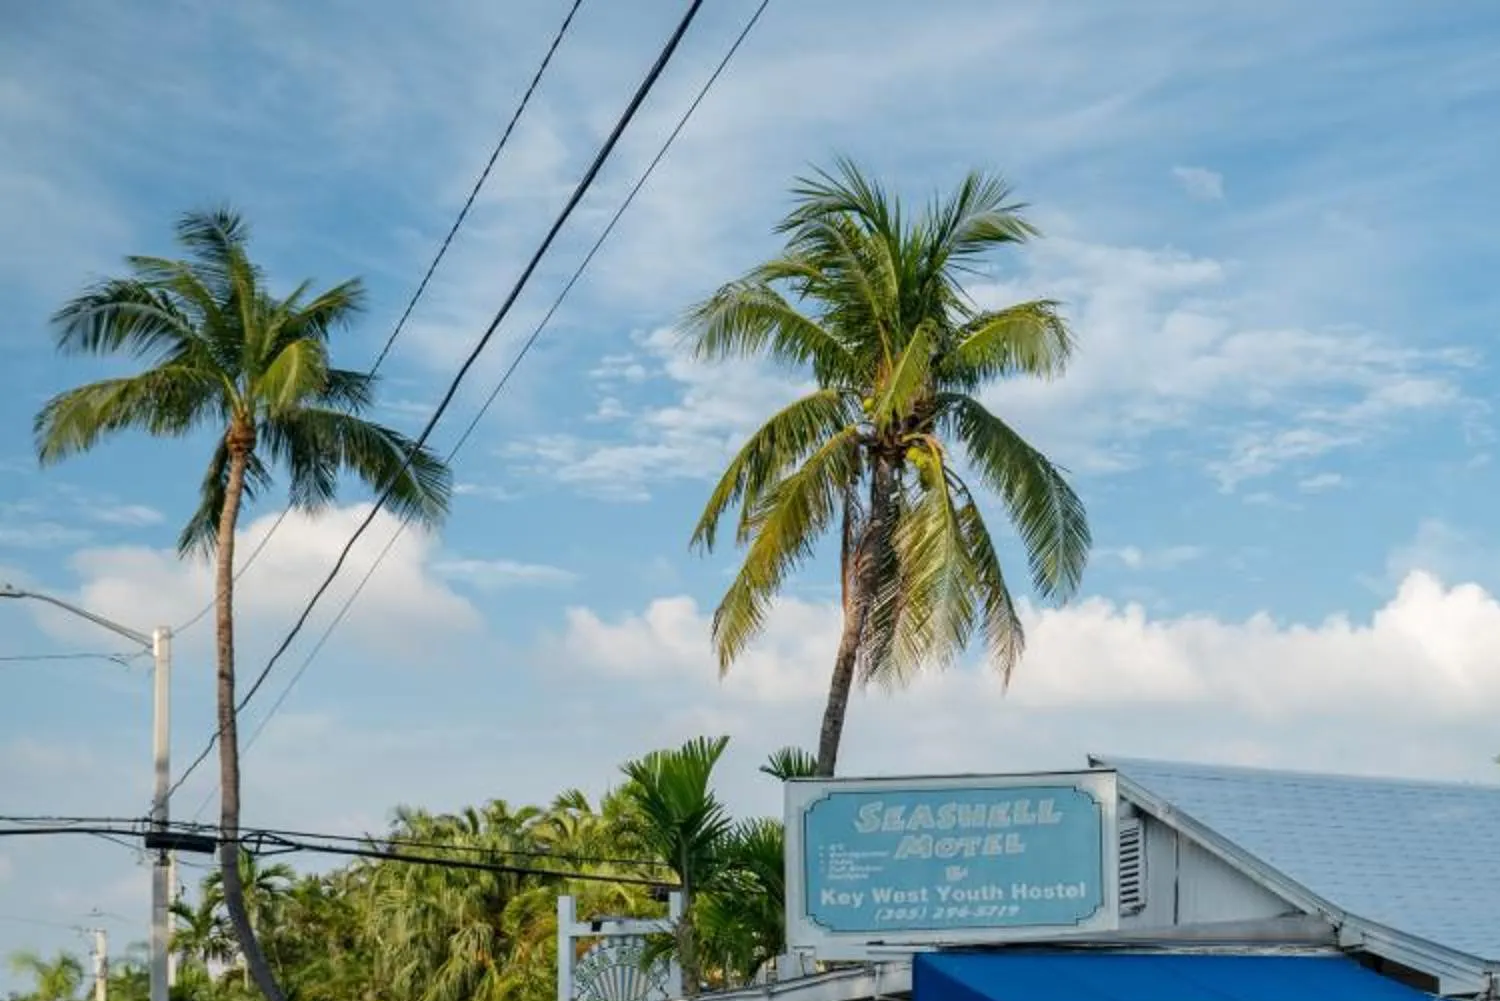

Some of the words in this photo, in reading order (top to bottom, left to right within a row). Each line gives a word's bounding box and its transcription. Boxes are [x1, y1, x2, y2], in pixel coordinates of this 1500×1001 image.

[855, 799, 1062, 832] SEASHELL
[895, 833, 1026, 859] MOTEL
[820, 889, 864, 909] Key
[871, 886, 929, 904] West
[936, 884, 1004, 901] Youth
[1011, 881, 1087, 900] Hostel
